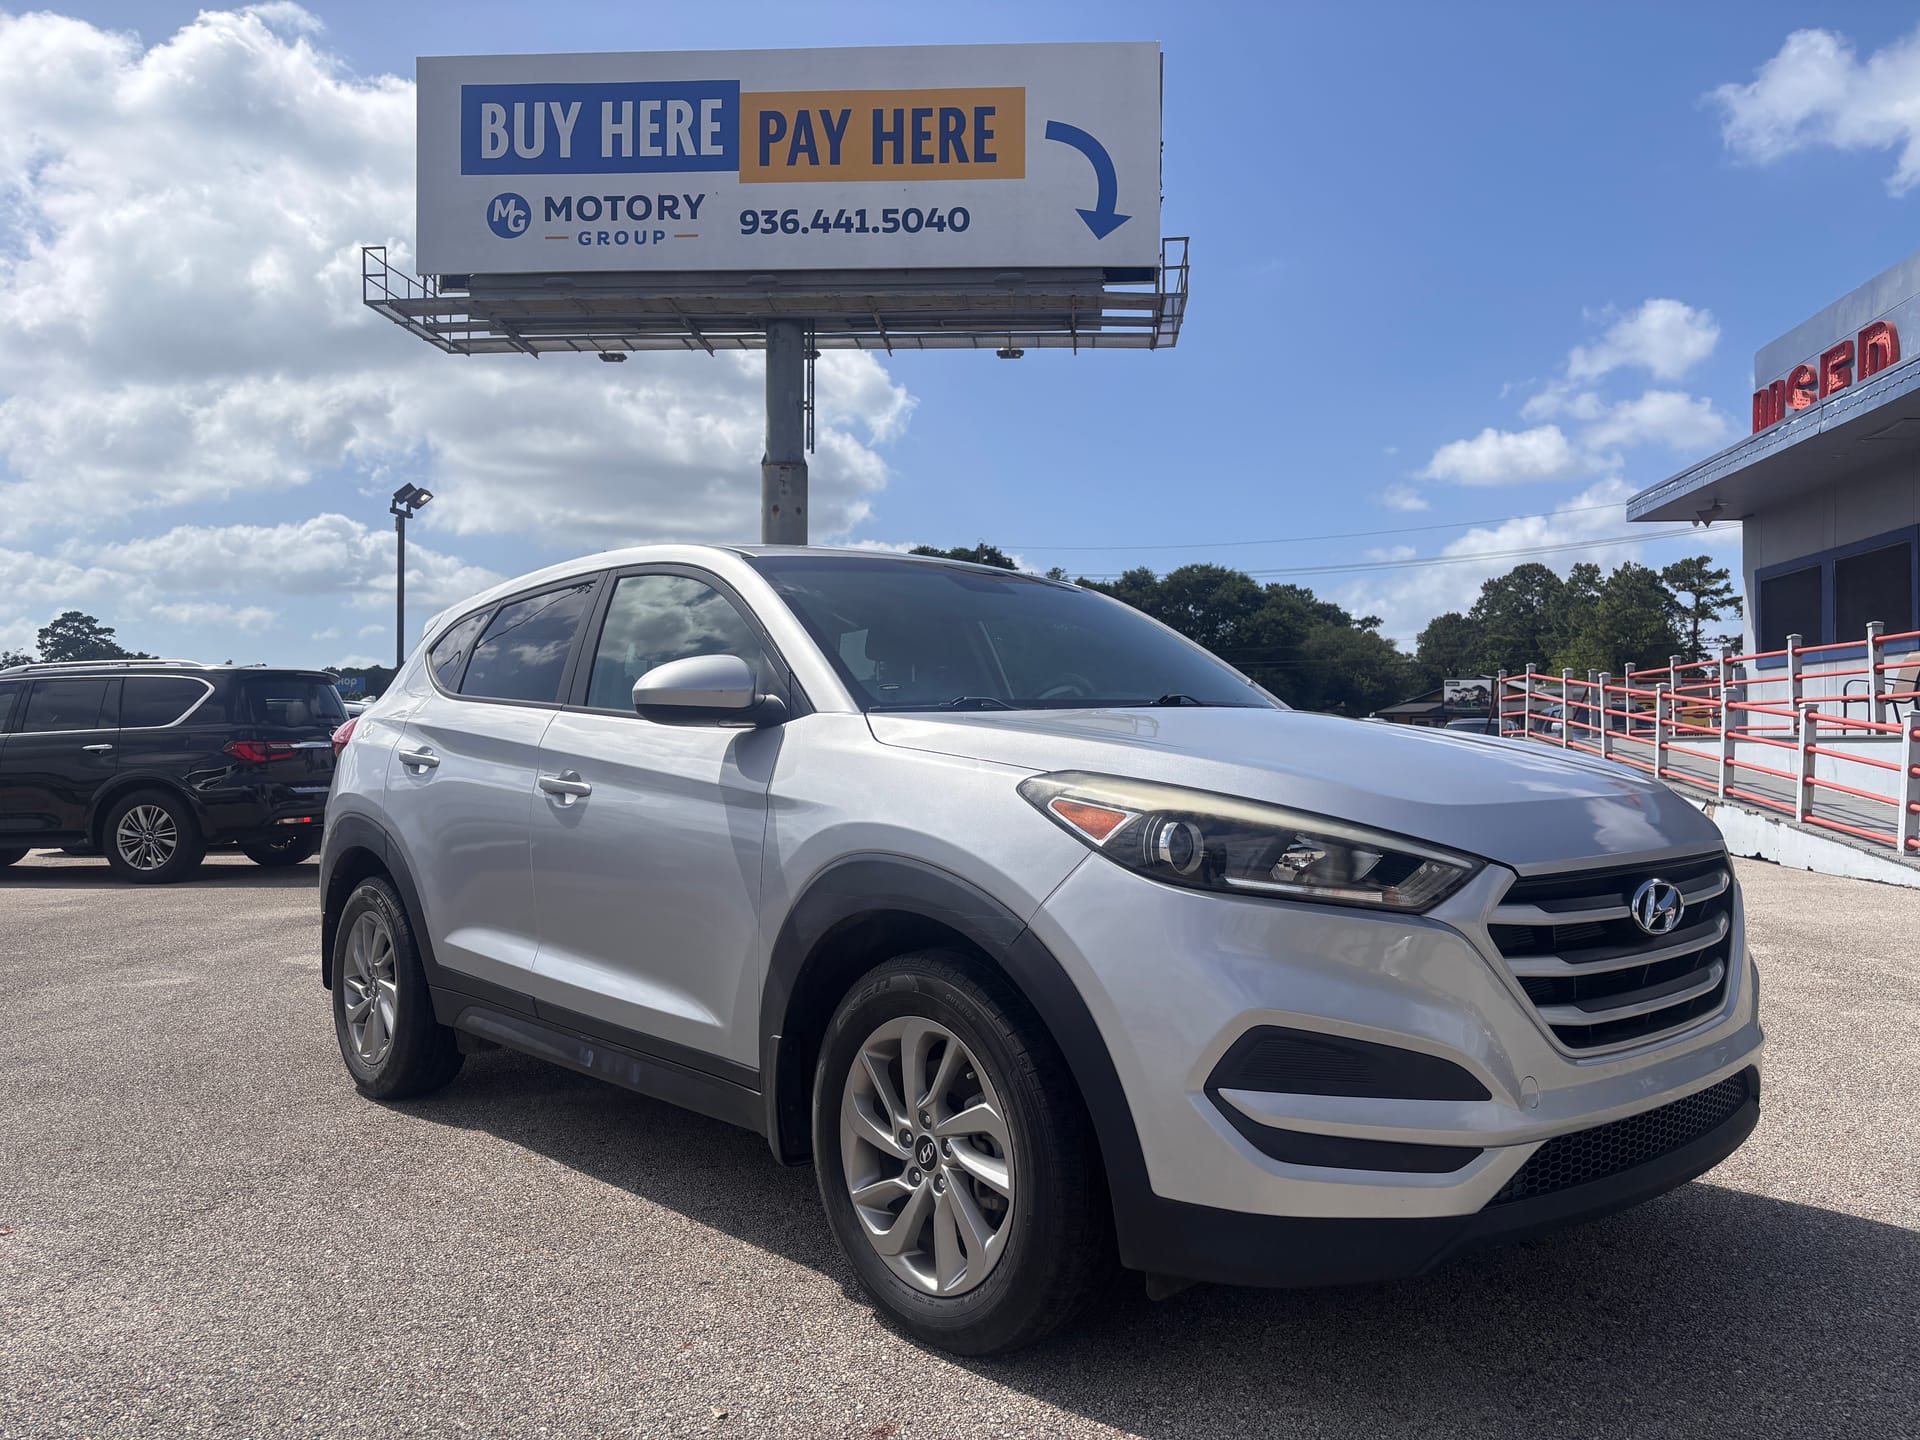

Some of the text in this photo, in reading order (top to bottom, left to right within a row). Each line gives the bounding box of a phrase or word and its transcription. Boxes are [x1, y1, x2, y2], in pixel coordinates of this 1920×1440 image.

[481, 98, 724, 159] BUY HERE
[758, 105, 998, 167] PAY HERE
[493, 199, 526, 233] MG
[544, 193, 706, 222] MOTORY
[739, 206, 971, 235] 936.441.5040
[577, 230, 666, 246] GROUP
